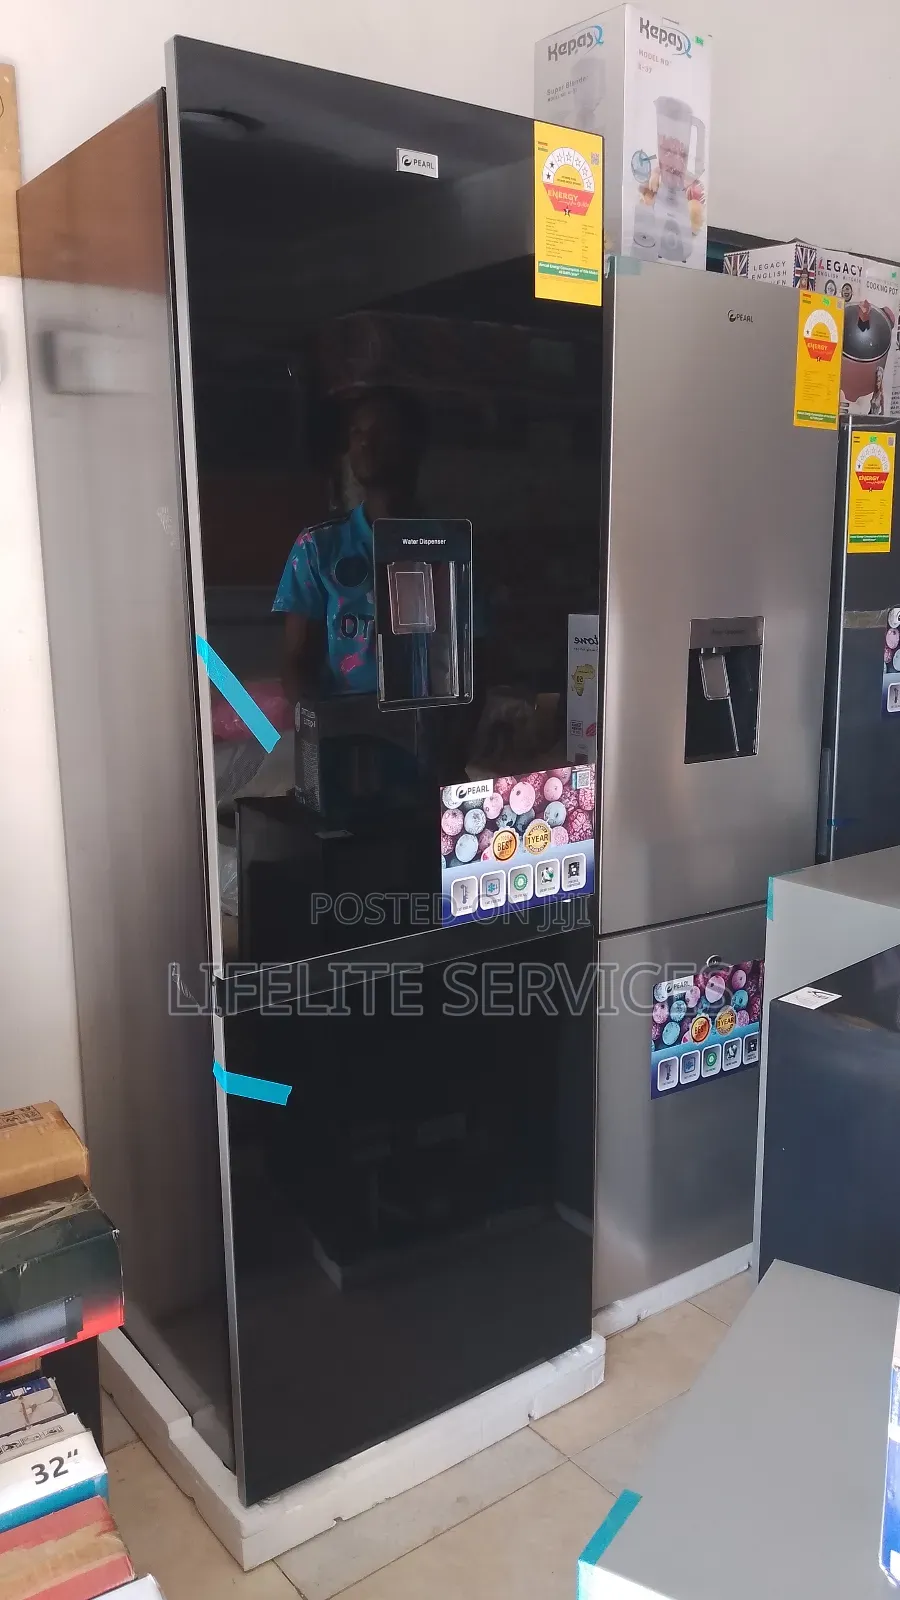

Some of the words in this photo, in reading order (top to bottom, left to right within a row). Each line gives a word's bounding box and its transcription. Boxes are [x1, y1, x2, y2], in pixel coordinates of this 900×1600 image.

[546, 84, 564, 96] Super
[413, 159, 435, 169] PEARL
[548, 189, 578, 202] ENERGY
[753, 261, 786, 271] LEGACY
[818, 258, 863, 278] LEGACY
[751, 270, 787, 280] ENGLISH
[866, 281, 888, 293] COOKING
[888, 286, 899, 296] POT
[736, 313, 754, 323] PEARL
[419, 538, 447, 546] Dispenser
[466, 785, 490, 796] PEARL
[497, 839, 513, 853] BEST
[674, 981, 691, 990] PEARL
